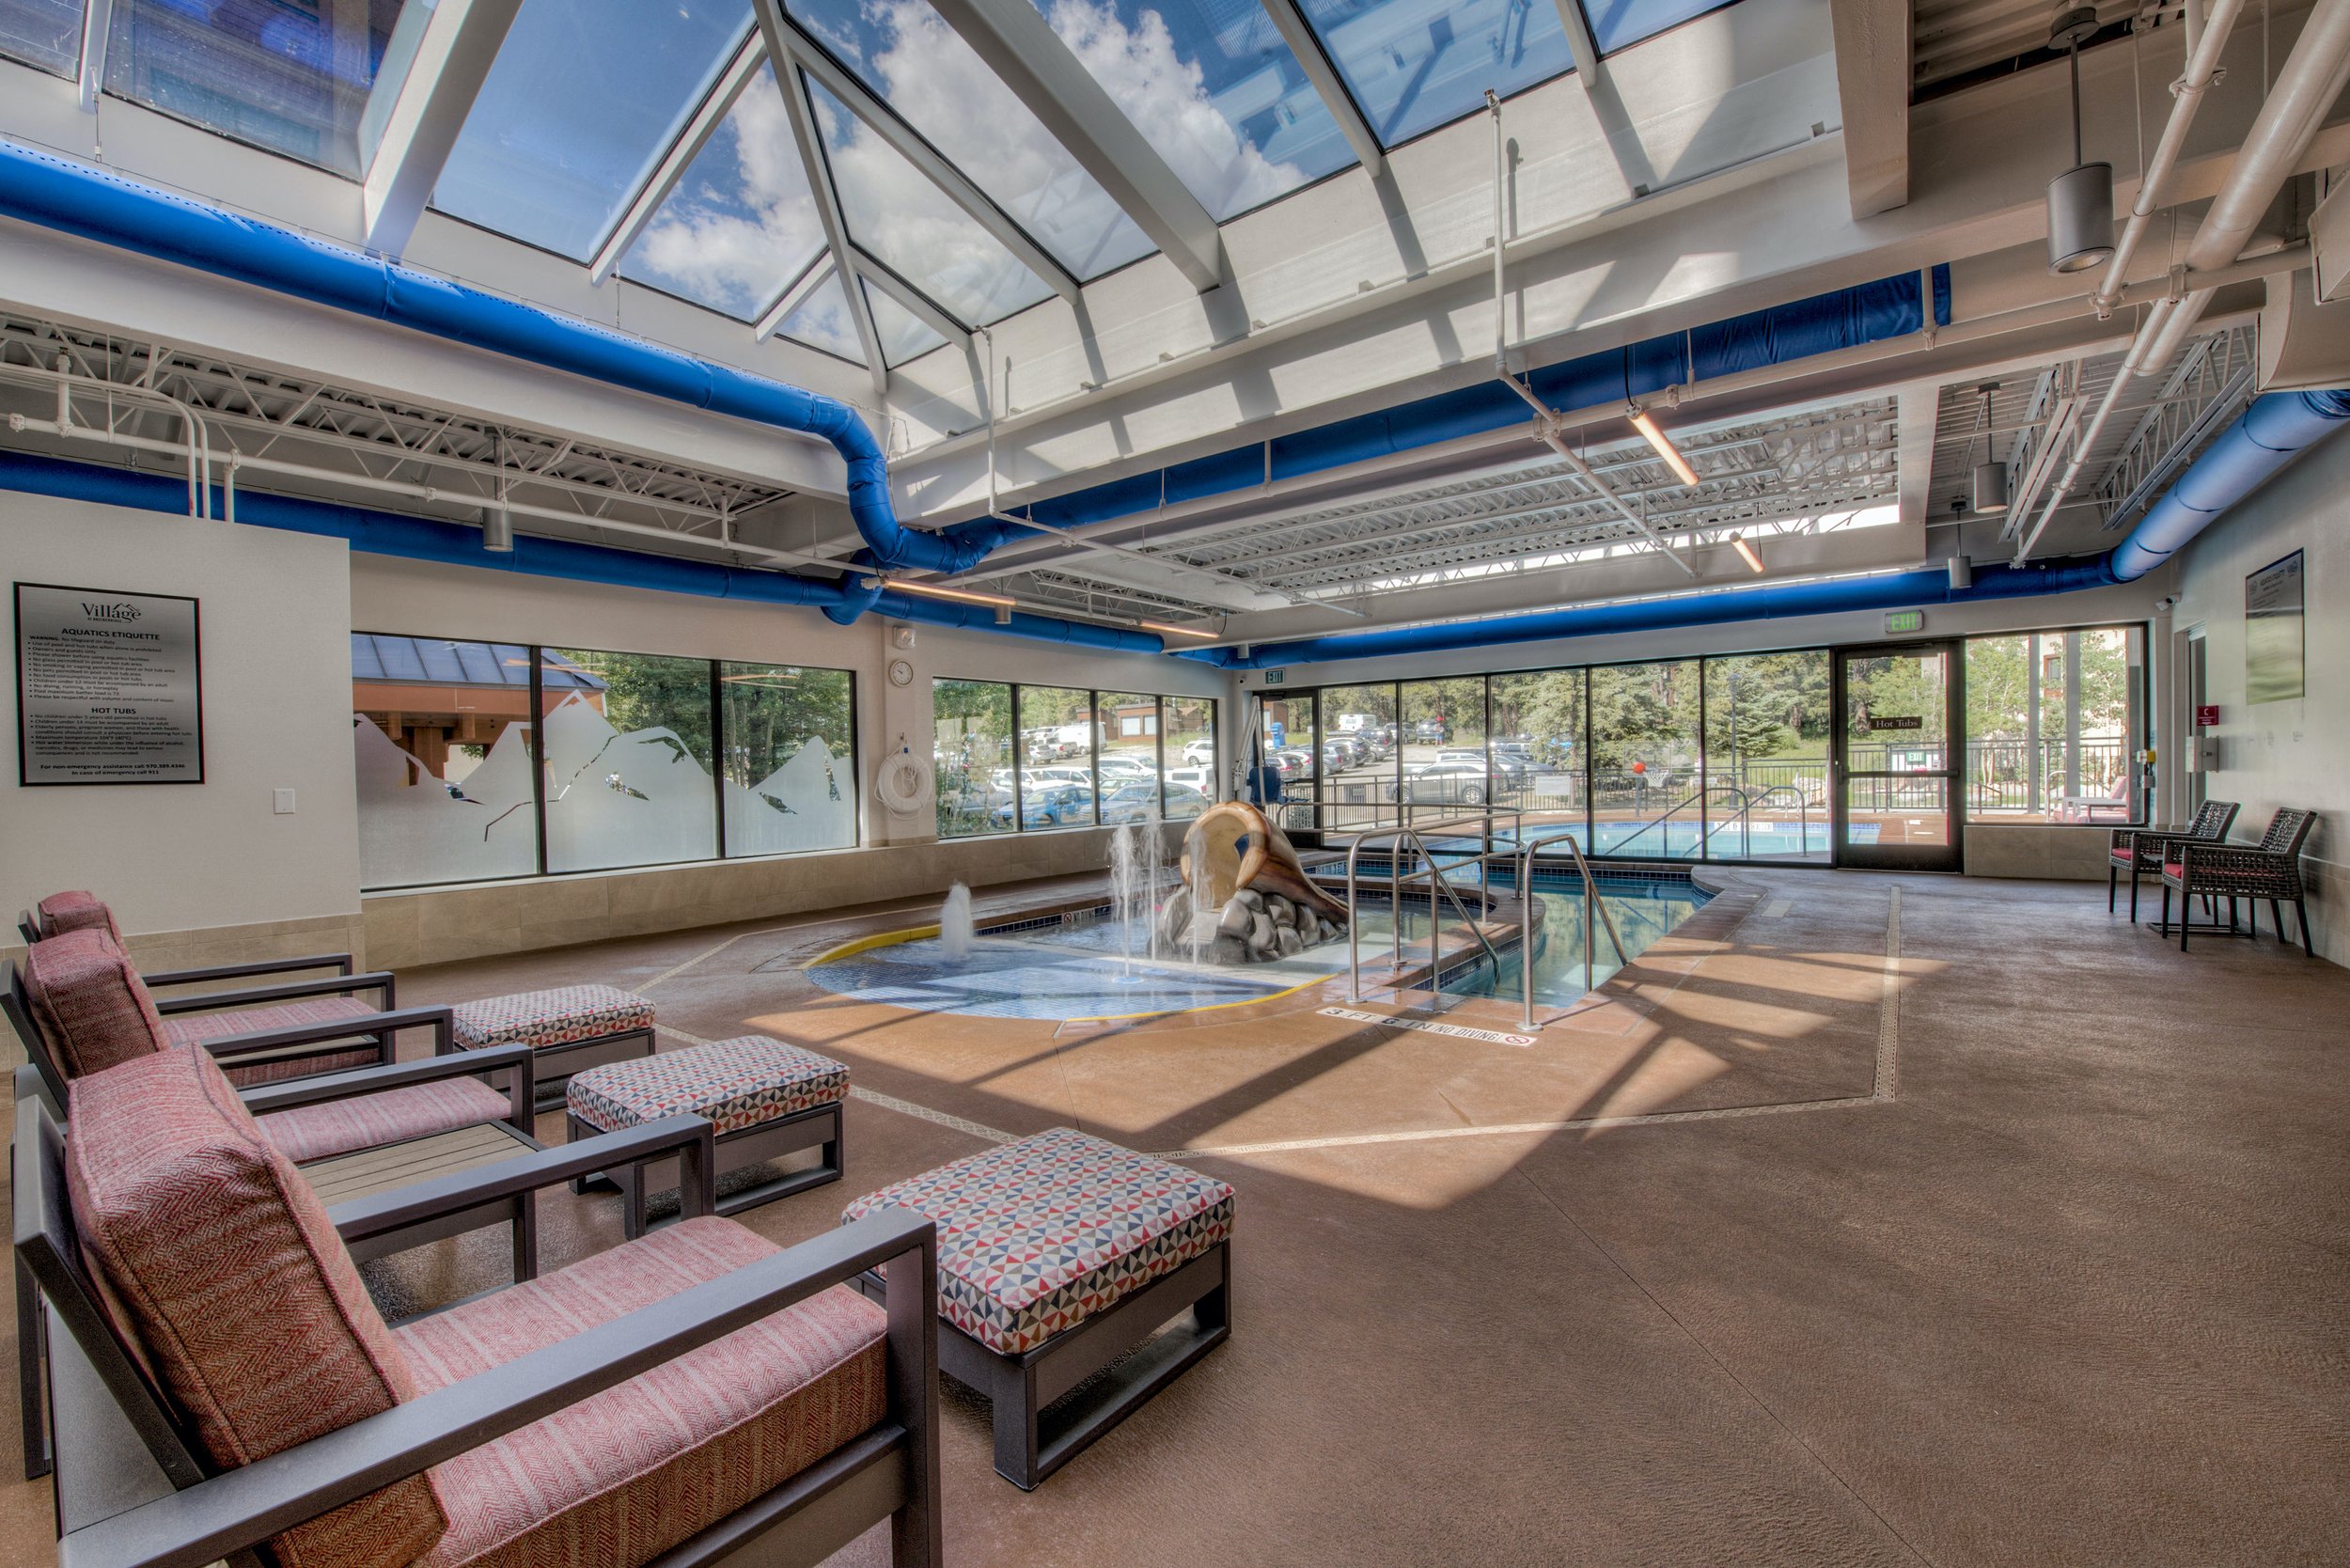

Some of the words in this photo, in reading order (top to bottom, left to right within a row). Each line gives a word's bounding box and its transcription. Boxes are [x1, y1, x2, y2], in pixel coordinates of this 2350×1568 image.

[81, 603, 141, 622] Village
[1891, 612, 1918, 632] EXIT
[62, 628, 109, 637] AQUATICS
[112, 631, 160, 640] ETIQUETTE
[1268, 670, 1282, 683] EXIT
[1876, 720, 1893, 729] Hot
[1896, 719, 1919, 728] Tubs
[1345, 1011, 1378, 1021] FT
[1404, 1021, 1435, 1031] IN
[1435, 1024, 1454, 1034] NO
[1455, 1027, 1500, 1042] DIVING
